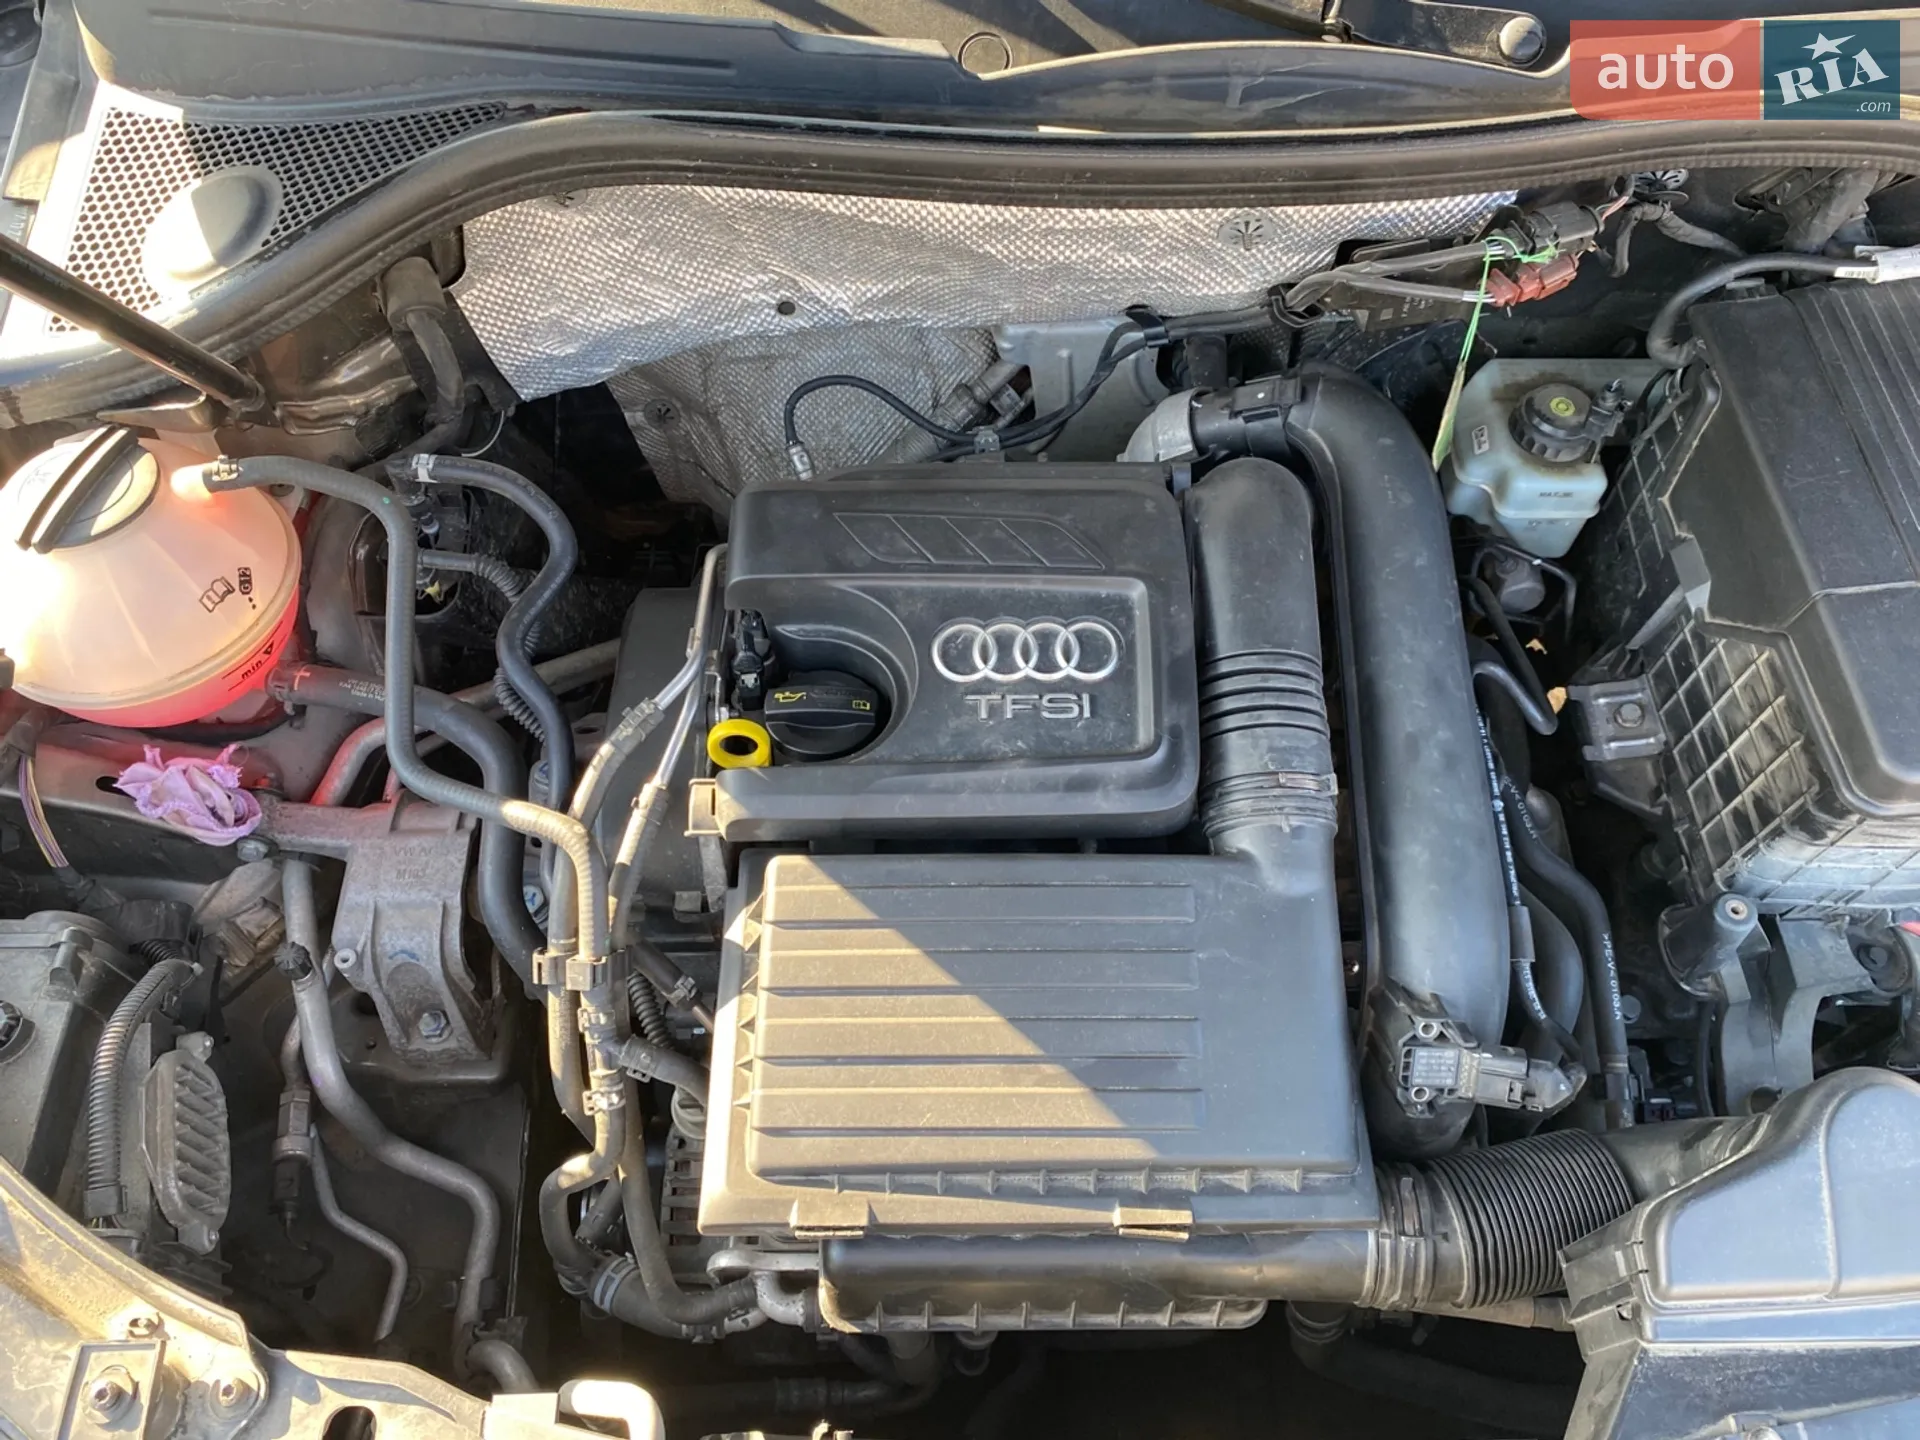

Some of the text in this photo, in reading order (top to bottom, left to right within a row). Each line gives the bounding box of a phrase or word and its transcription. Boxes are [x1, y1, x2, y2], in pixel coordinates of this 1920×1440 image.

[238, 568, 252, 594] G12
[241, 660, 263, 680] min
[963, 692, 1091, 721] TFSI
